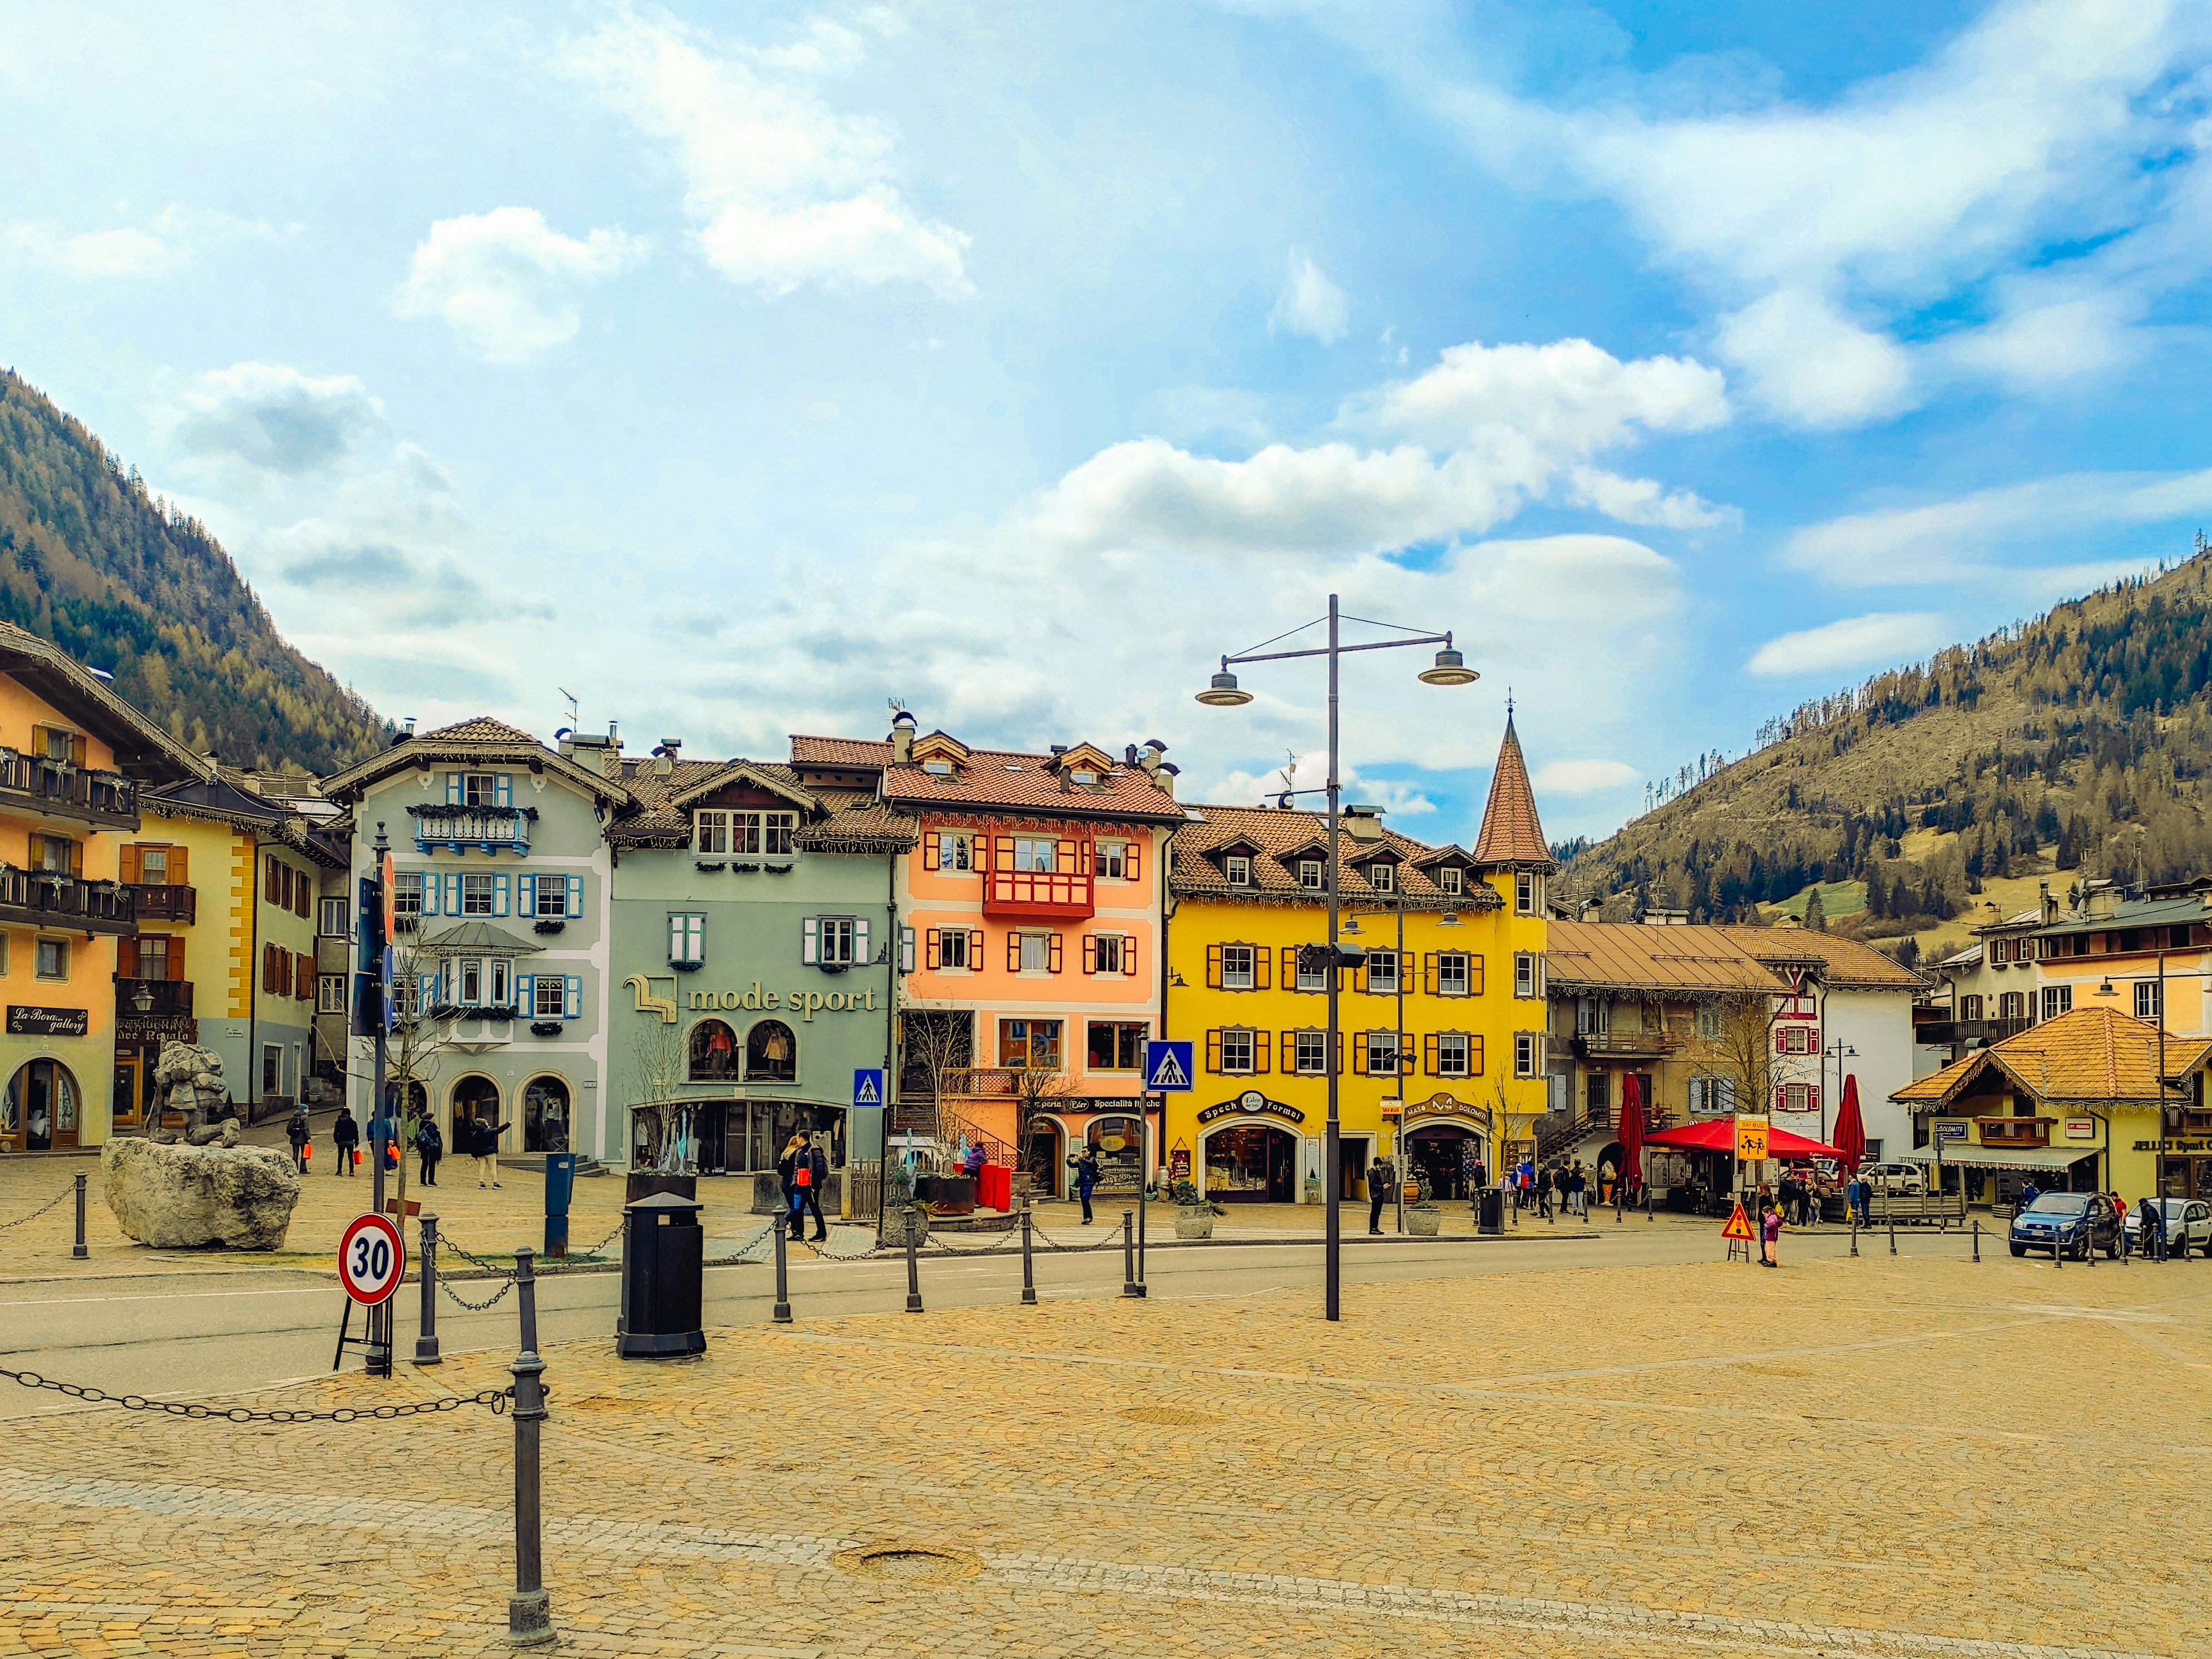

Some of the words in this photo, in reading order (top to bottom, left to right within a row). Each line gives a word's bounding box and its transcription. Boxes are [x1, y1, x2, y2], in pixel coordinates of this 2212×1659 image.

[687, 982, 779, 1010] mode
[788, 986, 876, 1021] sport
[13, 1008, 29, 1019] La
[49, 1018, 85, 1034] gallery
[1072, 1100, 1087, 1109] Eder
[1134, 1099, 1161, 1109] tiche
[1204, 1102, 1237, 1119] Spech
[1408, 1105, 1426, 1116] MASO
[2176, 1140, 2205, 1153] Sport
[352, 1237, 389, 1280] 30
